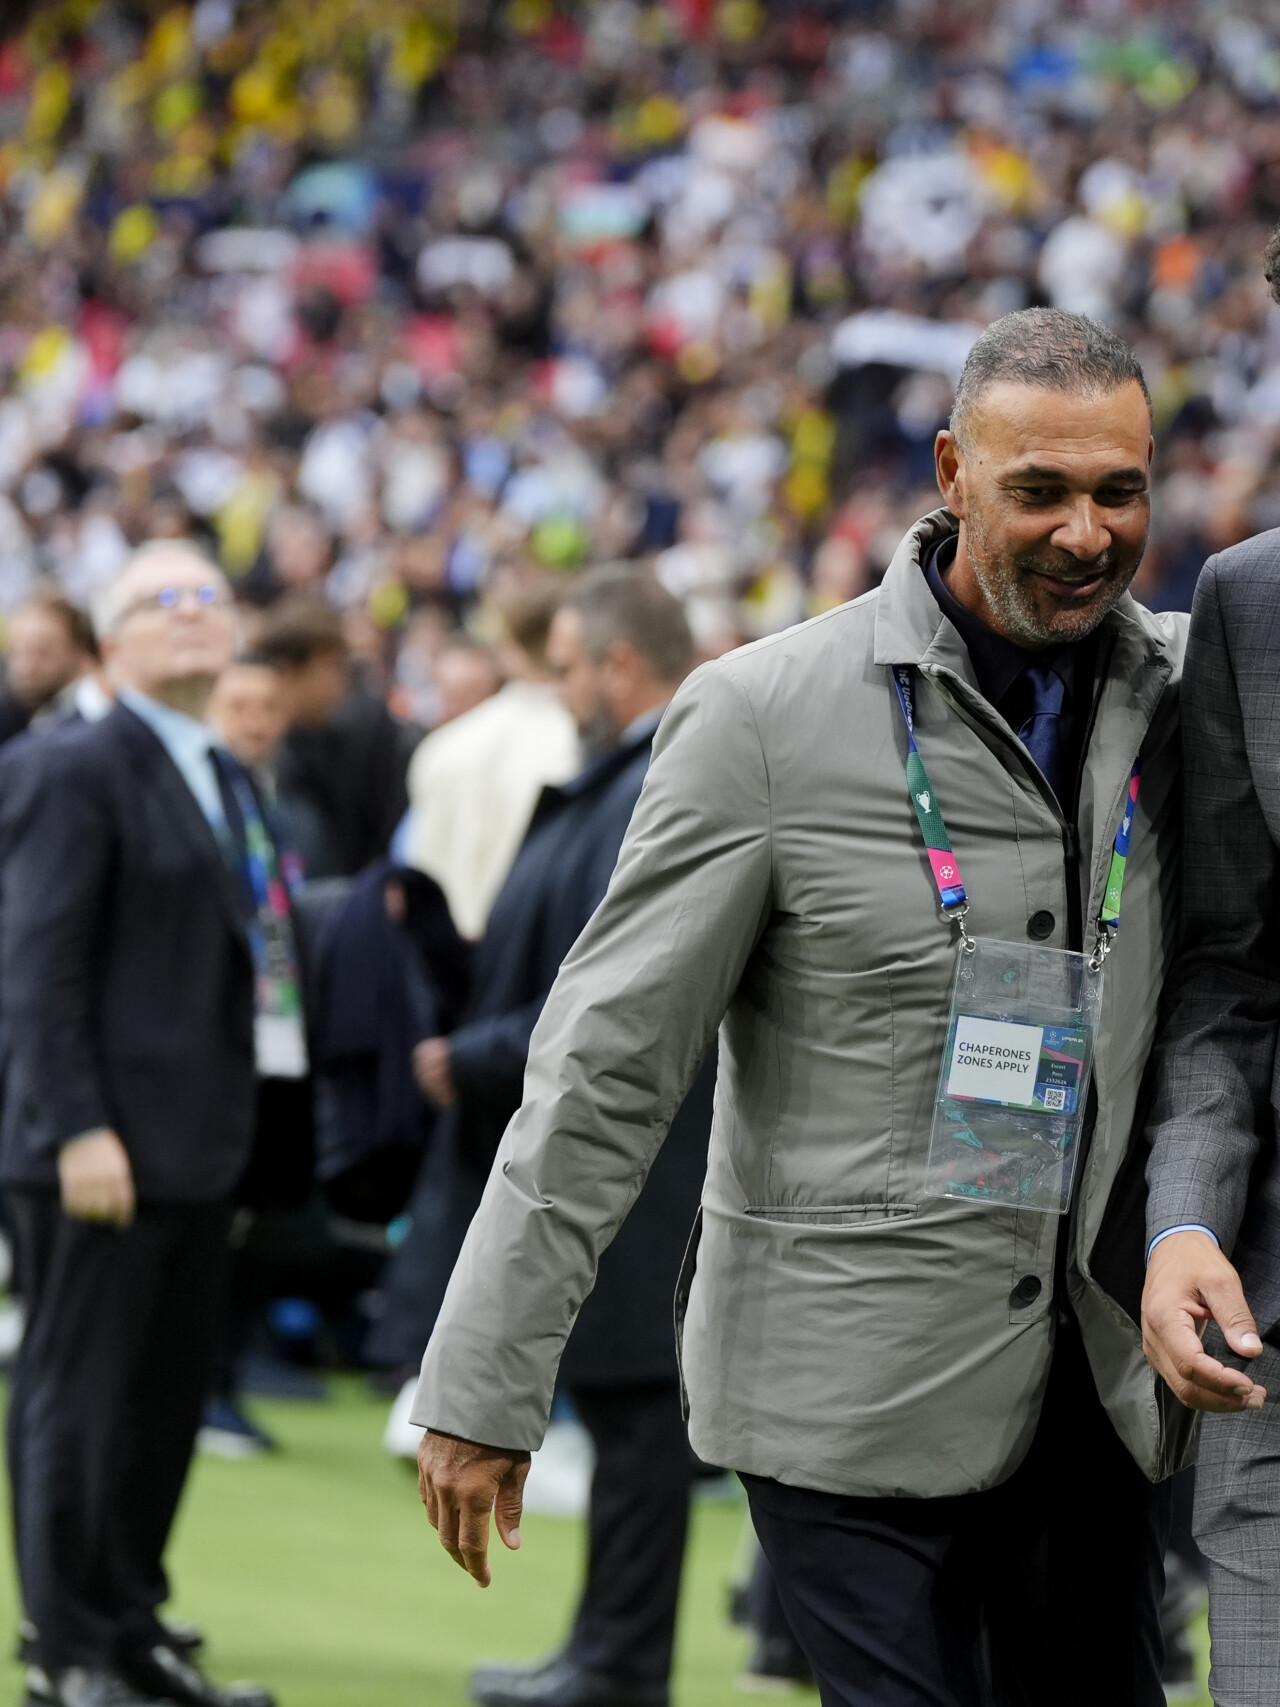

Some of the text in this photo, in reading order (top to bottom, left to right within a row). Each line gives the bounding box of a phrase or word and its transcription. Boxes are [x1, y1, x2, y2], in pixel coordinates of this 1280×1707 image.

[959, 1042, 1031, 1061] CHAPERONES
[957, 1055, 1029, 1074] ZONES APPLY
